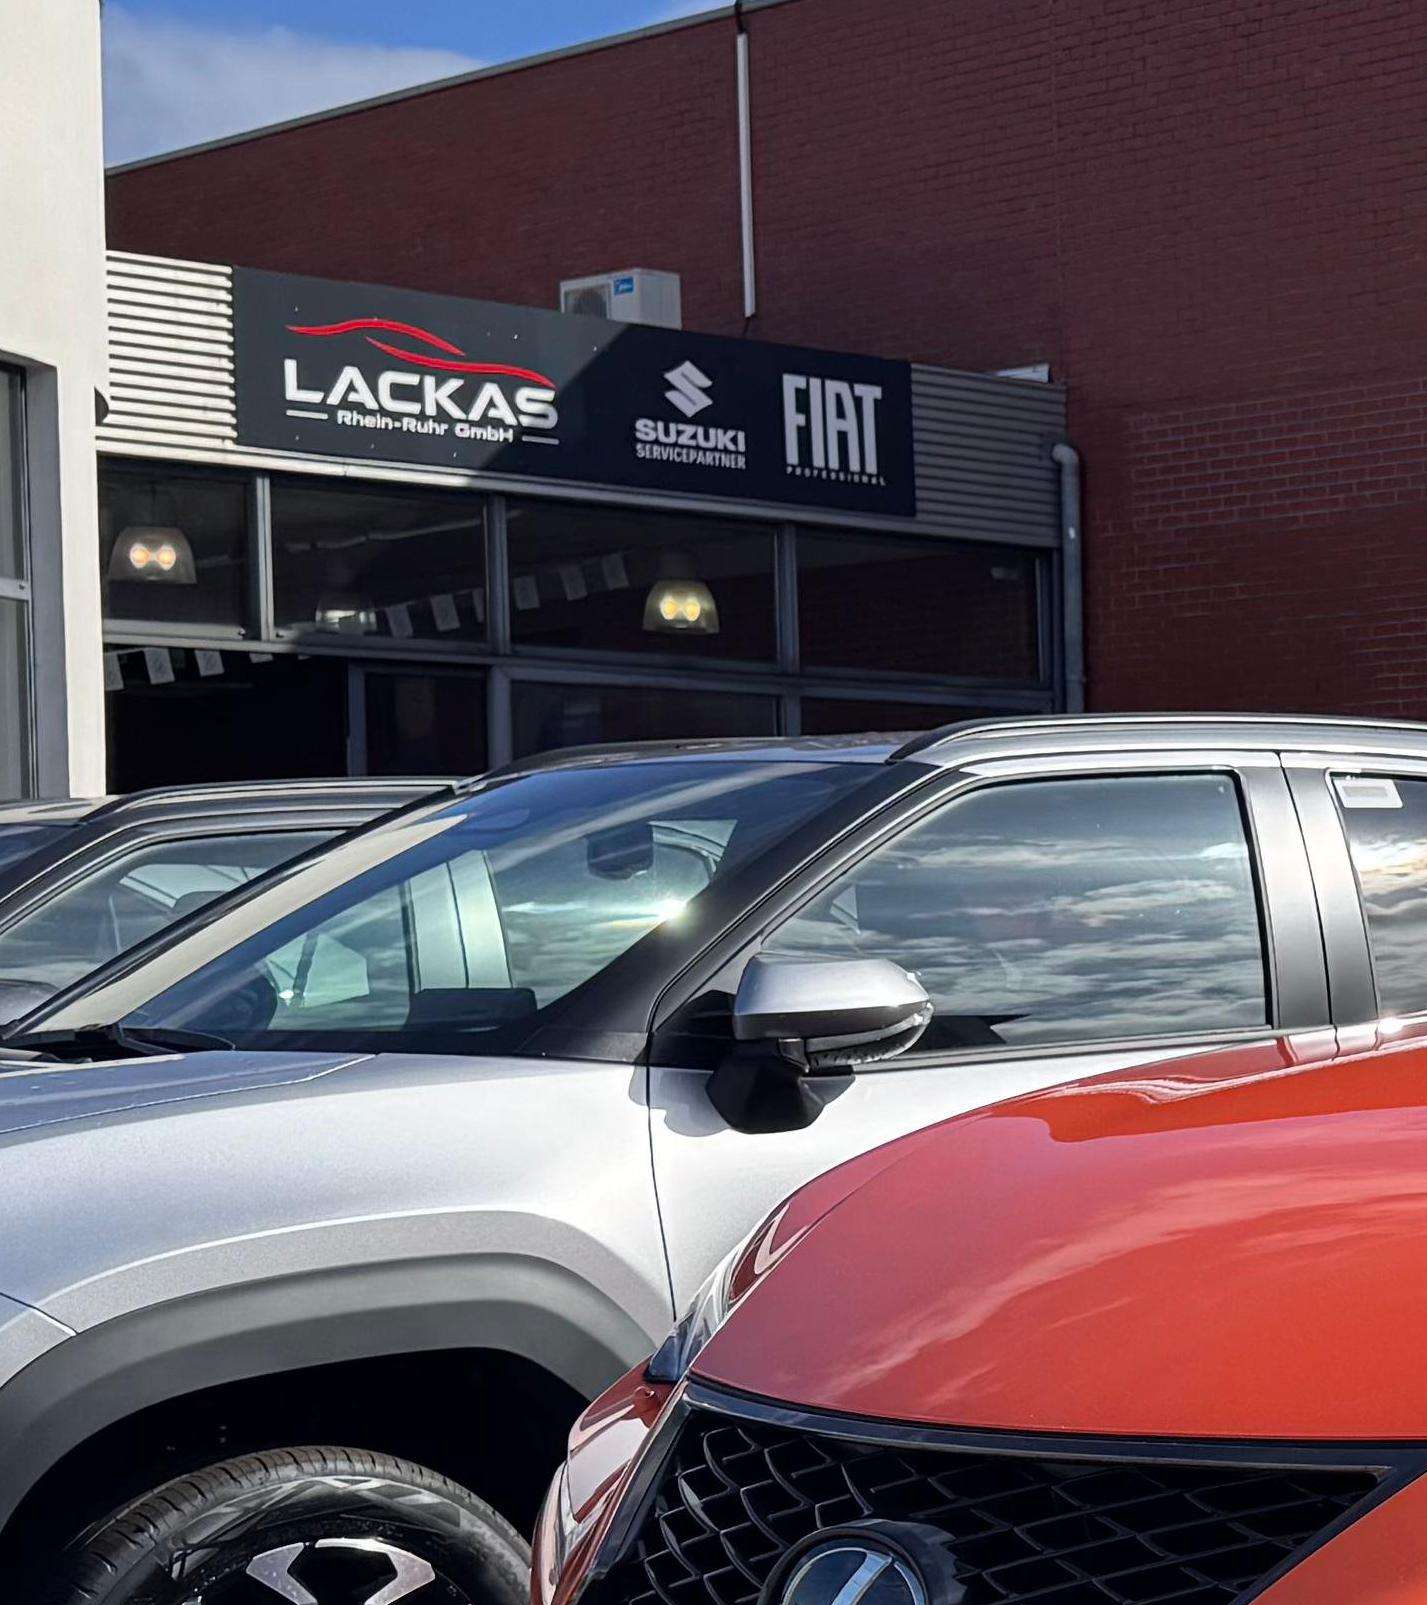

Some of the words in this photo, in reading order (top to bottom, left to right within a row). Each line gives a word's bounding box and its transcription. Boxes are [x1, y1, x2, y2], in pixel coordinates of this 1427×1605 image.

[284, 359, 558, 429] LACKAS
[337, 410, 449, 435] Rhein-Ruhr
[454, 423, 514, 442] GmbH
[635, 418, 746, 452] SUZUKI
[782, 373, 882, 475] FIAT
[636, 443, 746, 469] SERVICEPARTNER
